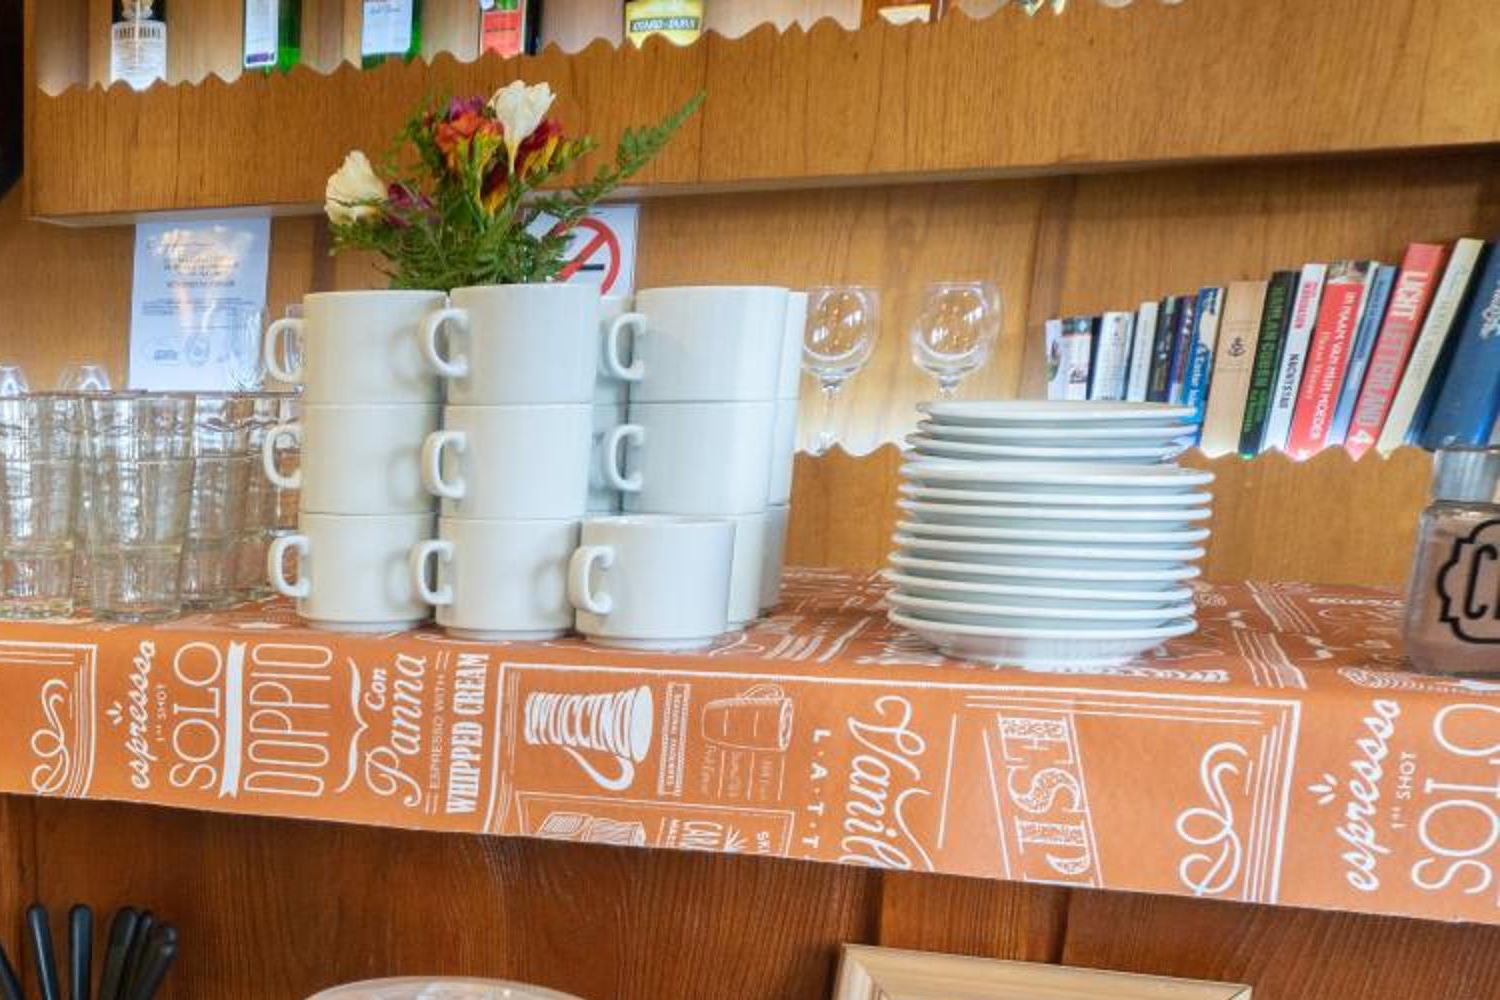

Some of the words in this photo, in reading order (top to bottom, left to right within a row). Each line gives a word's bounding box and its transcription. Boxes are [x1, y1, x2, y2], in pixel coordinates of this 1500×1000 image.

[125, 640, 158, 789] espresso
[169, 641, 223, 789] SOLO
[244, 643, 333, 797] DOPPIO
[364, 667, 387, 711] Con
[365, 652, 428, 808] Panna
[452, 653, 491, 715] CREAM
[446, 720, 484, 813] WHIPPED
[997, 712, 1095, 887] ESP
[1338, 699, 1402, 892] espresso
[1400, 751, 1417, 799] SHOT
[1411, 702, 1500, 895] SOLO
